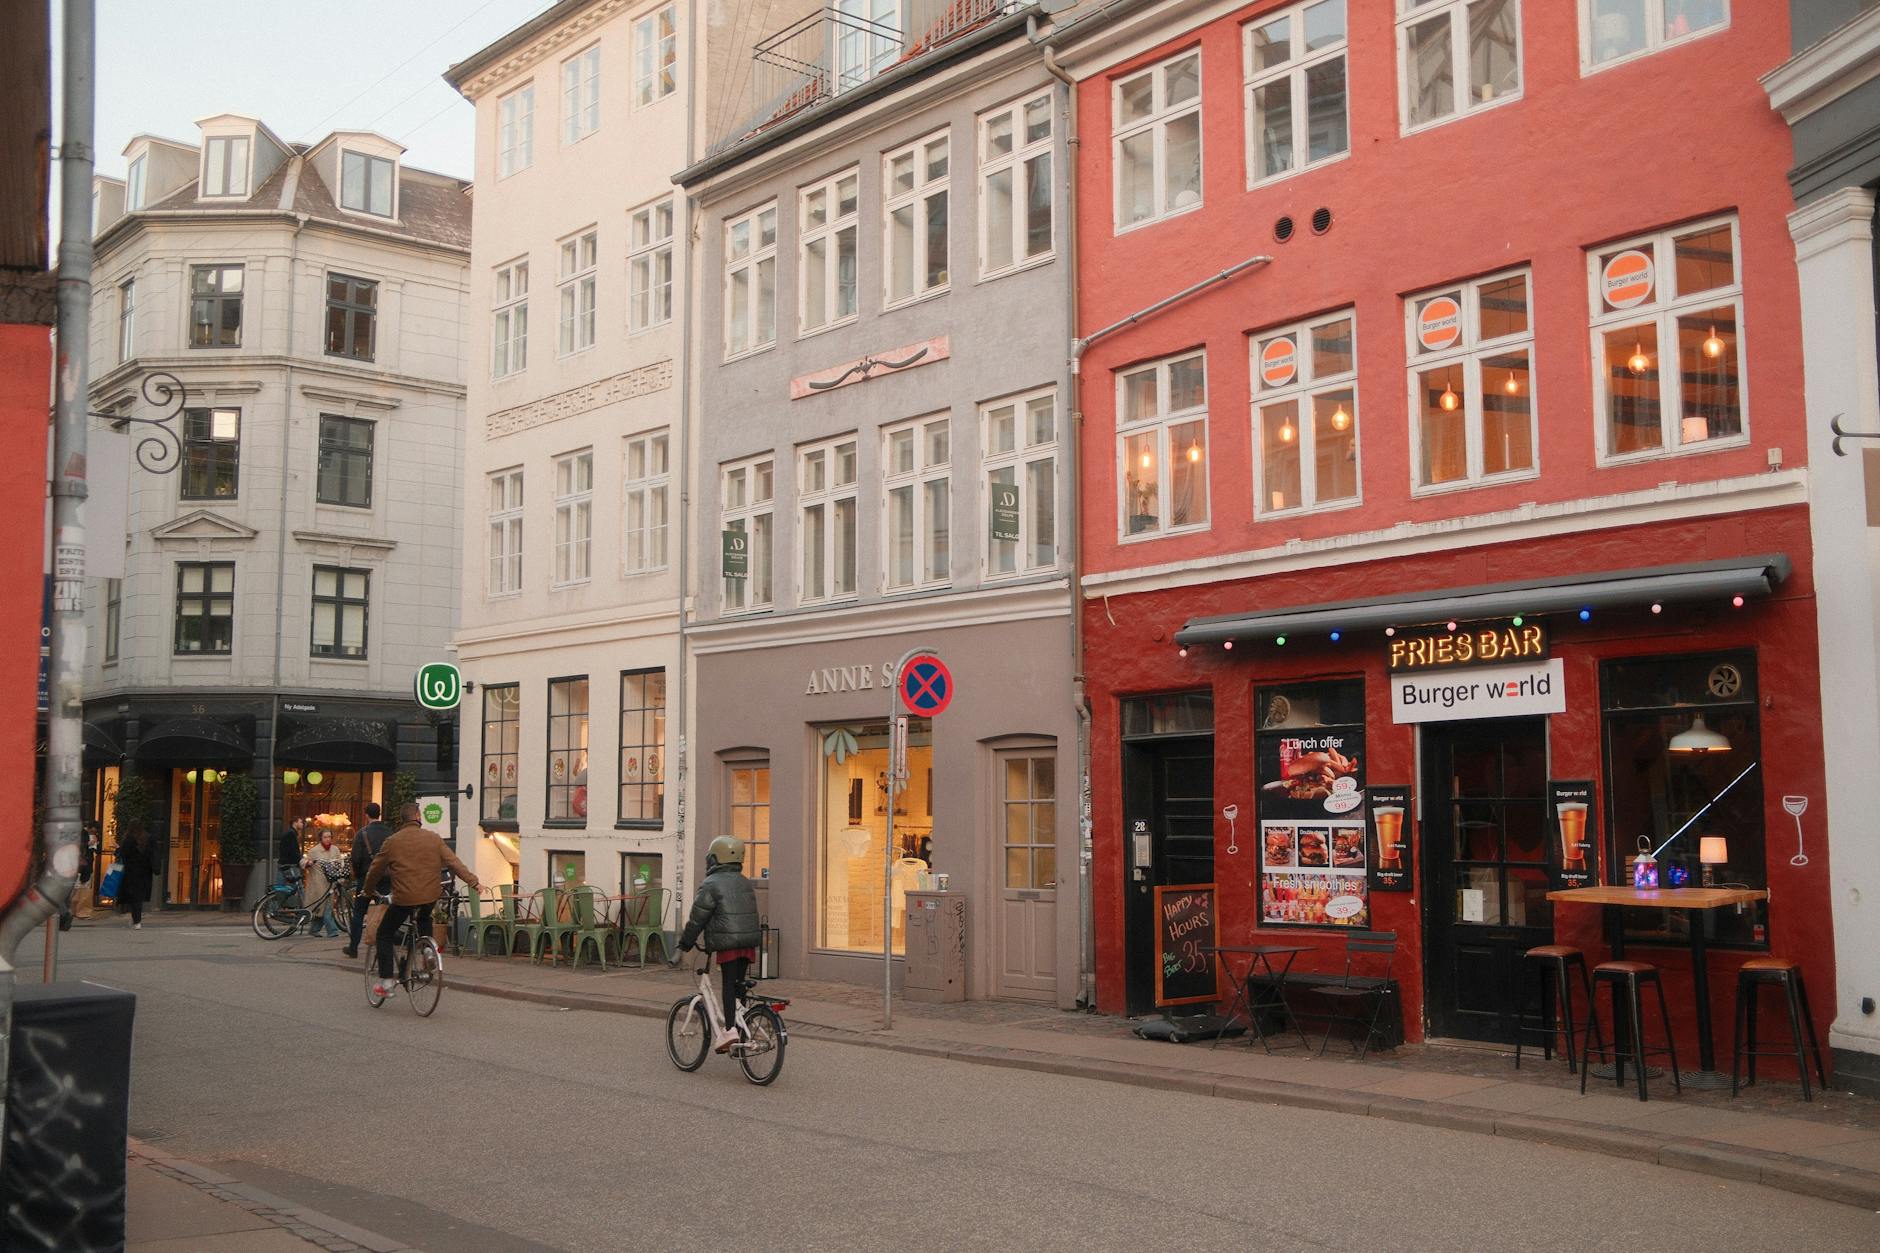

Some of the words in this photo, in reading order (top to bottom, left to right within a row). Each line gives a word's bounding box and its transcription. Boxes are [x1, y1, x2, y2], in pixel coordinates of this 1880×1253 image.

[1607, 277, 1630, 288] Burger
[1631, 271, 1649, 281] world
[1423, 321, 1441, 331] Burger
[1391, 633, 1473, 668] FRIES
[1479, 625, 1542, 659] BAR
[804, 664, 873, 695] ANNE
[1402, 682, 1479, 708] Burger
[1286, 737, 1318, 749] Lunch
[1319, 736, 1344, 749] offer
[1134, 821, 1146, 832] 28
[1273, 876, 1301, 889] Fresh
[1304, 878, 1357, 891] smoothies
[1168, 911, 1209, 942] HOURS
